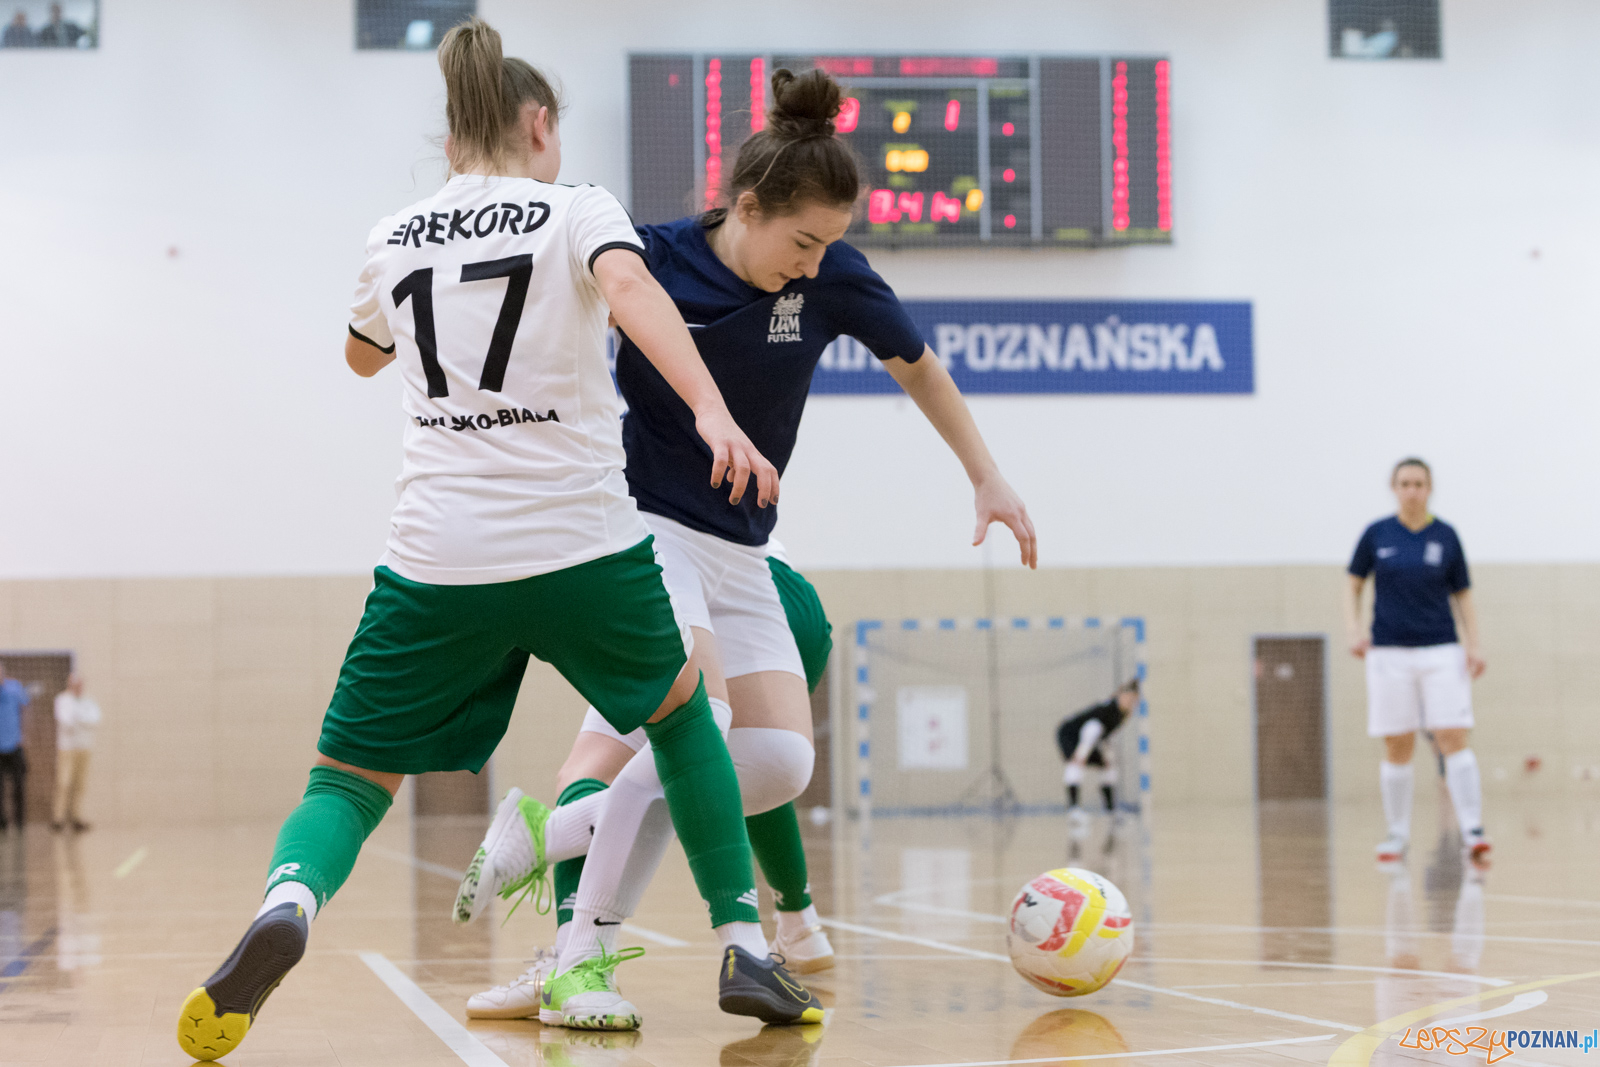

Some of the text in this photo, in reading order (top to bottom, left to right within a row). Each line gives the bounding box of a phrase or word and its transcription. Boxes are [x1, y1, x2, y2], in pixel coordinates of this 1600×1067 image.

[388, 201, 551, 248] REKORD
[391, 253, 534, 399] 17
[767, 332, 803, 343] FUTSAL
[934, 313, 1225, 371] POZNAŃSKA
